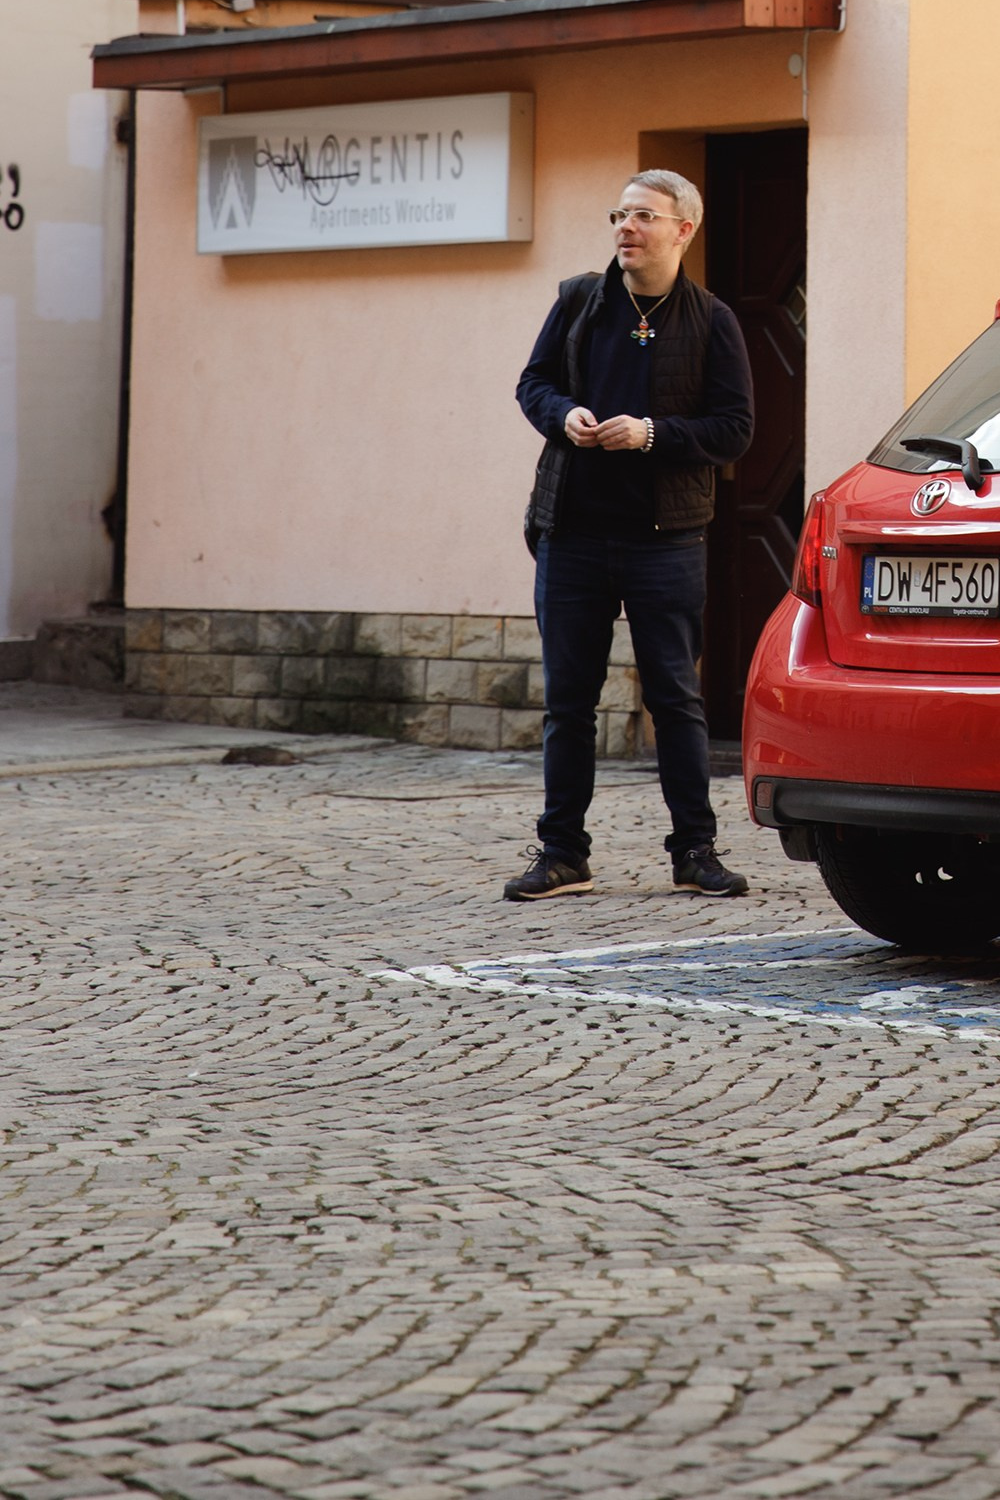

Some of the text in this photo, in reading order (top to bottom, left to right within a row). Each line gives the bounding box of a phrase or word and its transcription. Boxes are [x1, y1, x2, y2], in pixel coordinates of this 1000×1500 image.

[309, 197, 457, 234] Apartments Wrocław
[864, 587, 873, 598] PL
[877, 561, 995, 603] DW 4F560
